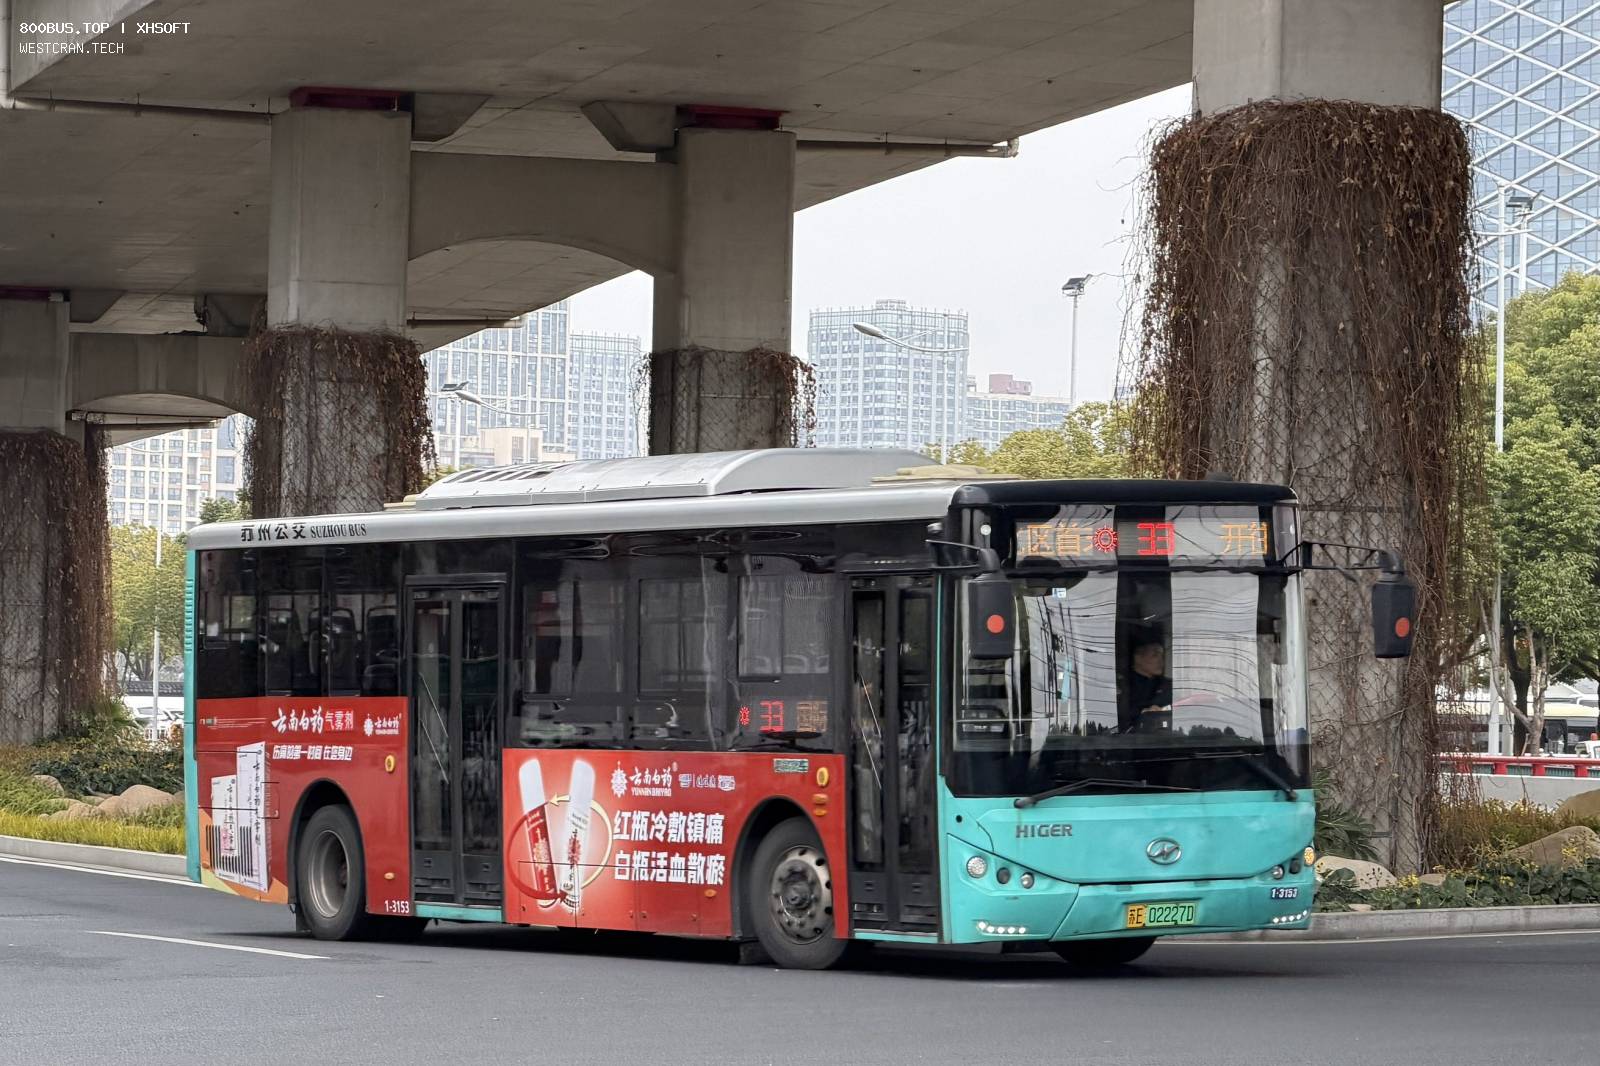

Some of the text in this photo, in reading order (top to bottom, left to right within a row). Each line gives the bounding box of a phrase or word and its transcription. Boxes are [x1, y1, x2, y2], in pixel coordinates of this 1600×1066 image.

[240, 522, 367, 542] 苏州公交 SUZHOU BUS
[1137, 523, 1175, 555] 33
[271, 705, 324, 734] 云南白药
[760, 700, 784, 732] 33
[629, 766, 672, 788] 云南白药
[612, 810, 725, 844] 红瓶冷敷镇痛
[1015, 824, 1073, 839] HIGER
[614, 850, 726, 885] 白瓶活血散瘀
[1271, 888, 1298, 898] 1-3153
[384, 900, 410, 914] 1-3153
[1148, 905, 1195, 924] 02227D
